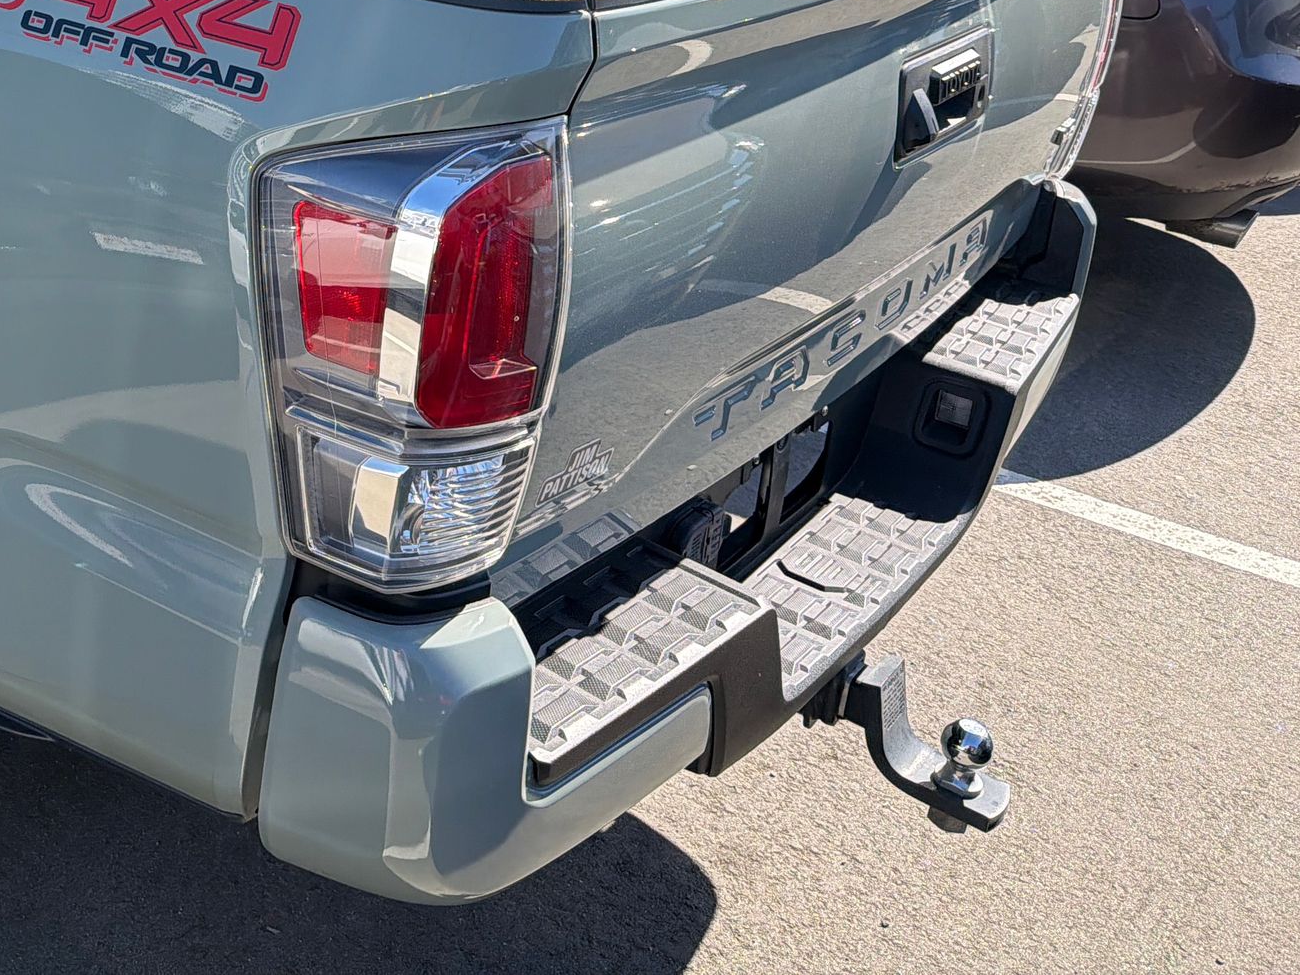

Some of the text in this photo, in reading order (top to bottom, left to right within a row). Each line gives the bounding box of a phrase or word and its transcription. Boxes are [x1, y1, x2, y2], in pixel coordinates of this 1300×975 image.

[20, 10, 270, 103] OFF ROAD
[941, 60, 981, 99] TOYOTA
[692, 215, 989, 441] TACOMA
[540, 453, 610, 501] PATTISON
[567, 444, 598, 472] JIM
